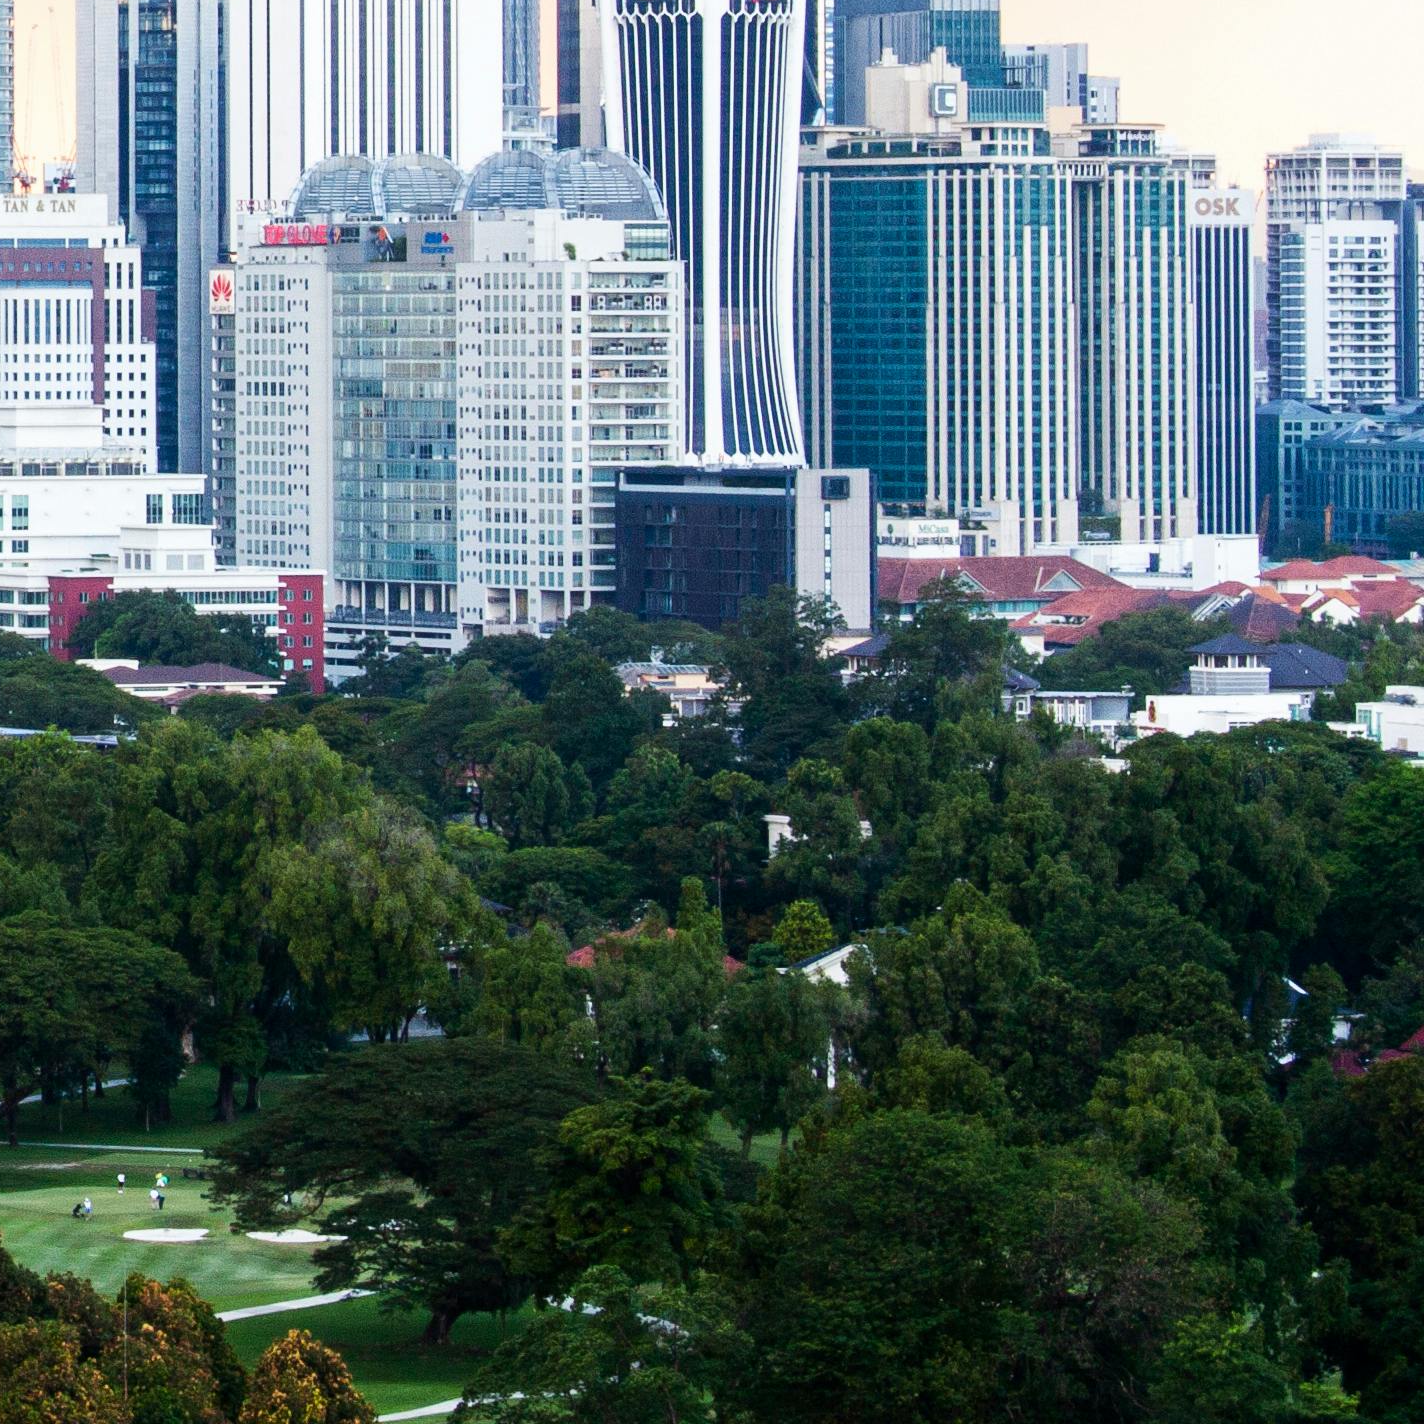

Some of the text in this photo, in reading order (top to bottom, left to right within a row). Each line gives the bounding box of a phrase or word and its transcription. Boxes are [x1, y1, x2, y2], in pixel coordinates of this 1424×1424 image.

[3, 199, 76, 213] TAN & TAN
[1194, 197, 1241, 216] OSK
[287, 225, 327, 244] GLOVE
